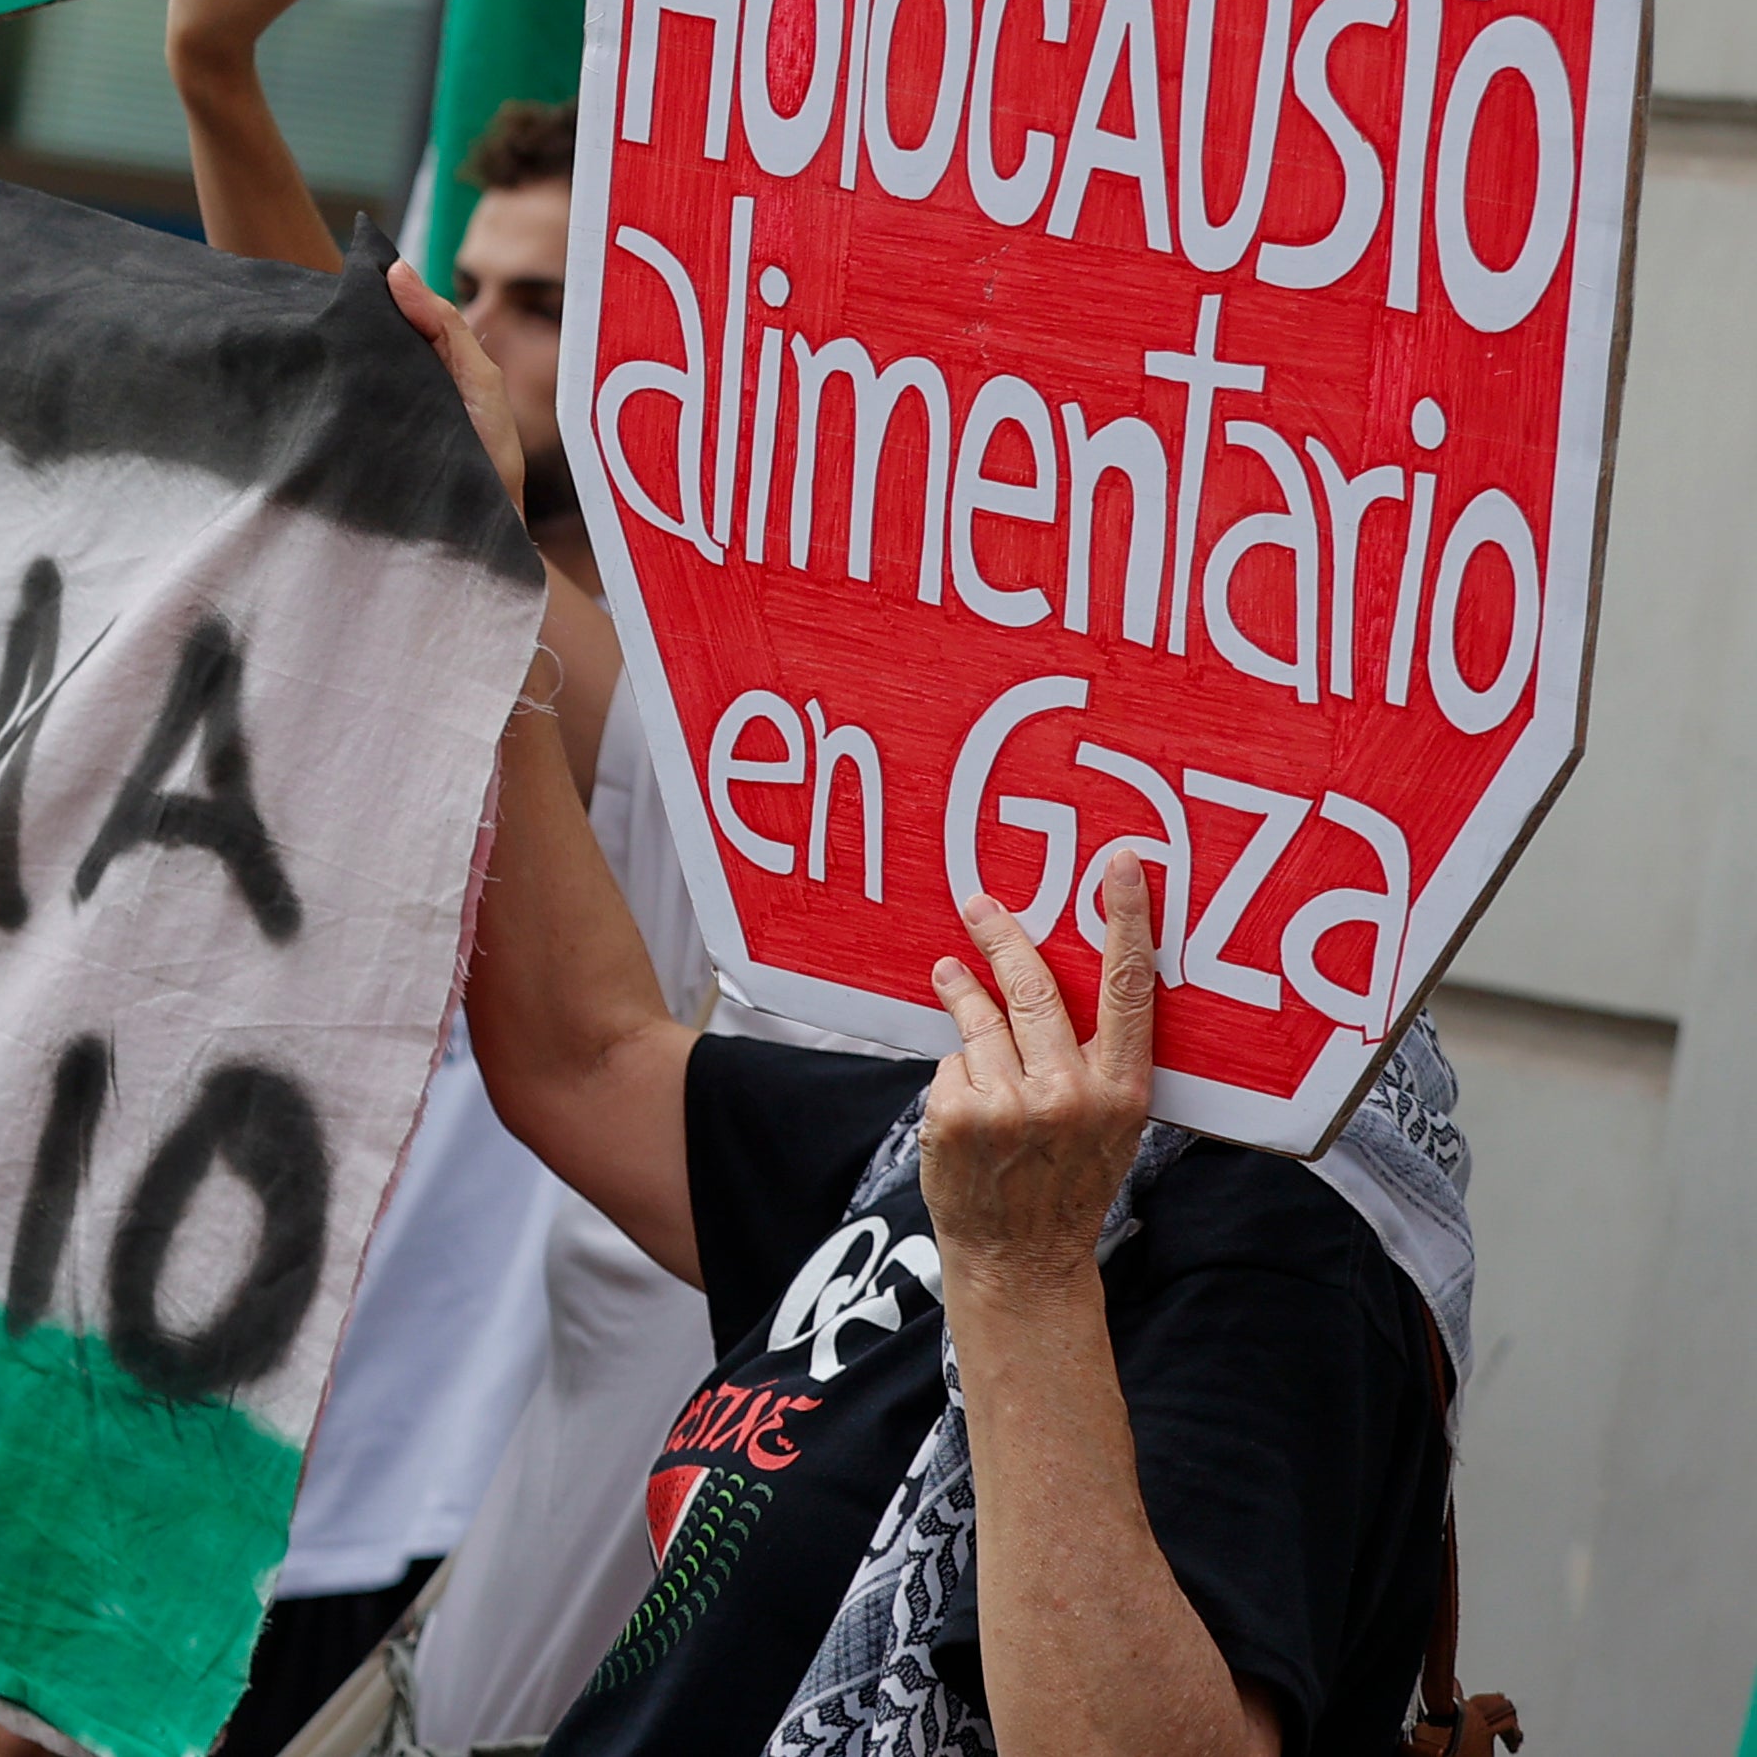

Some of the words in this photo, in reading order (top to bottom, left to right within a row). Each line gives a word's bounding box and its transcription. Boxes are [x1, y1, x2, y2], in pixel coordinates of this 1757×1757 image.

[597, 195, 1541, 735] alimentario
[708, 689, 883, 903] en
[944, 675, 1411, 1048] Gaza
